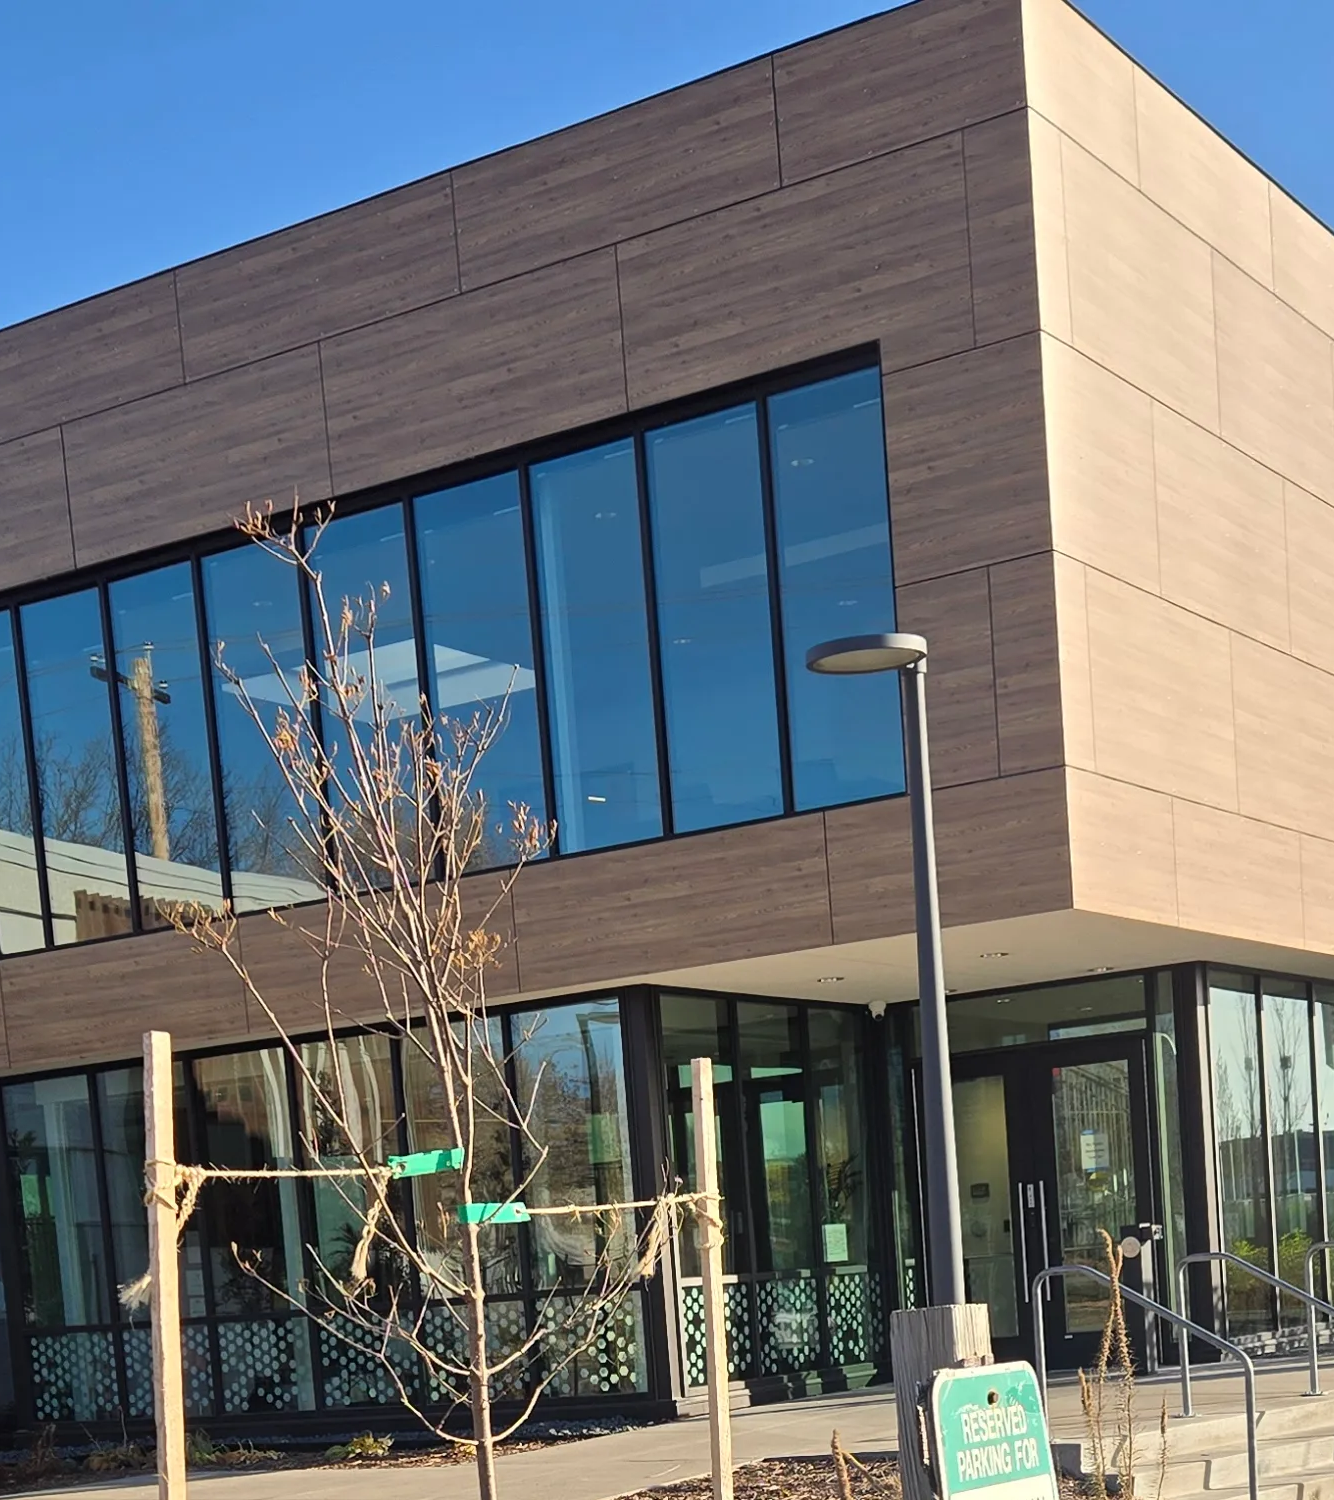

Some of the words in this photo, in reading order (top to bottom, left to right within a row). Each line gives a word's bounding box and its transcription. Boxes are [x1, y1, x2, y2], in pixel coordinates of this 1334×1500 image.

[960, 1403, 1028, 1445] RESERVED
[956, 1442, 1013, 1483] PARKING
[1014, 1437, 1040, 1471] FOR
